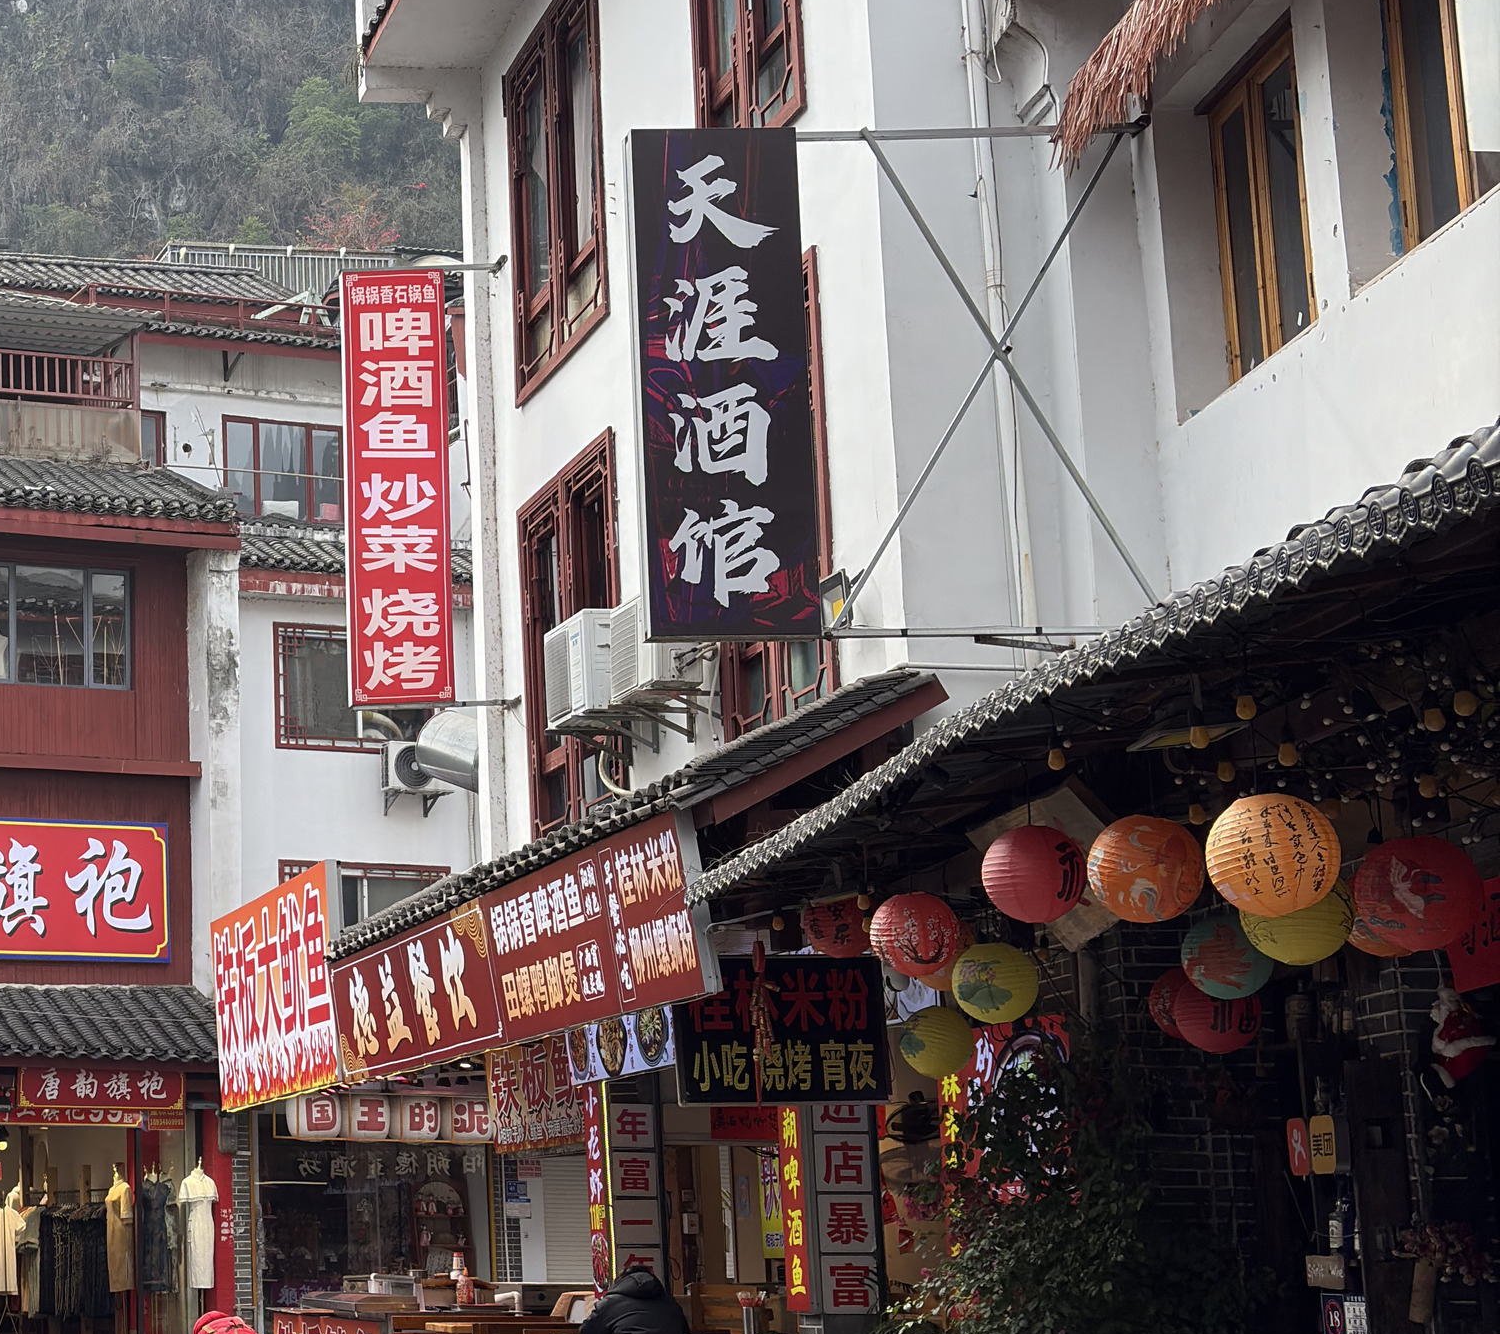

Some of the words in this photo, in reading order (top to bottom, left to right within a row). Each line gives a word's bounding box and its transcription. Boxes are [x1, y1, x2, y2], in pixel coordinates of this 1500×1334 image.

[351, 284, 438, 305] 锅锅香石锅鱼
[359, 308, 437, 458] 啤酒鱼
[663, 154, 782, 609] 天涯酒馆
[360, 472, 439, 573] 炒菜
[363, 588, 442, 691] 烧烤
[614, 828, 682, 909] 桂林米粉
[490, 872, 586, 956] 锅锅香啤酒鱼
[603, 859, 633, 991] 早餐必吃
[627, 909, 698, 986] 柳州螺蛳粉
[214, 883, 332, 1054] 铁板大鱿鱼
[348, 925, 479, 1058] 德益餐饮
[501, 951, 581, 1022] 田螺鸭脚煲
[688, 968, 869, 1033] 桂林米粉
[36, 1066, 168, 1101] 唐韵旗袍
[693, 1040, 750, 1092] 小吃
[760, 1039, 812, 1092] 烧烤
[819, 1038, 877, 1091] 宵夜
[305, 1096, 490, 1136] 国王的泥
[1312, 1132, 1334, 1157] 美团
[782, 1107, 807, 1296] 朔啤酒鱼
[1328, 1311, 1341, 1328] 18
